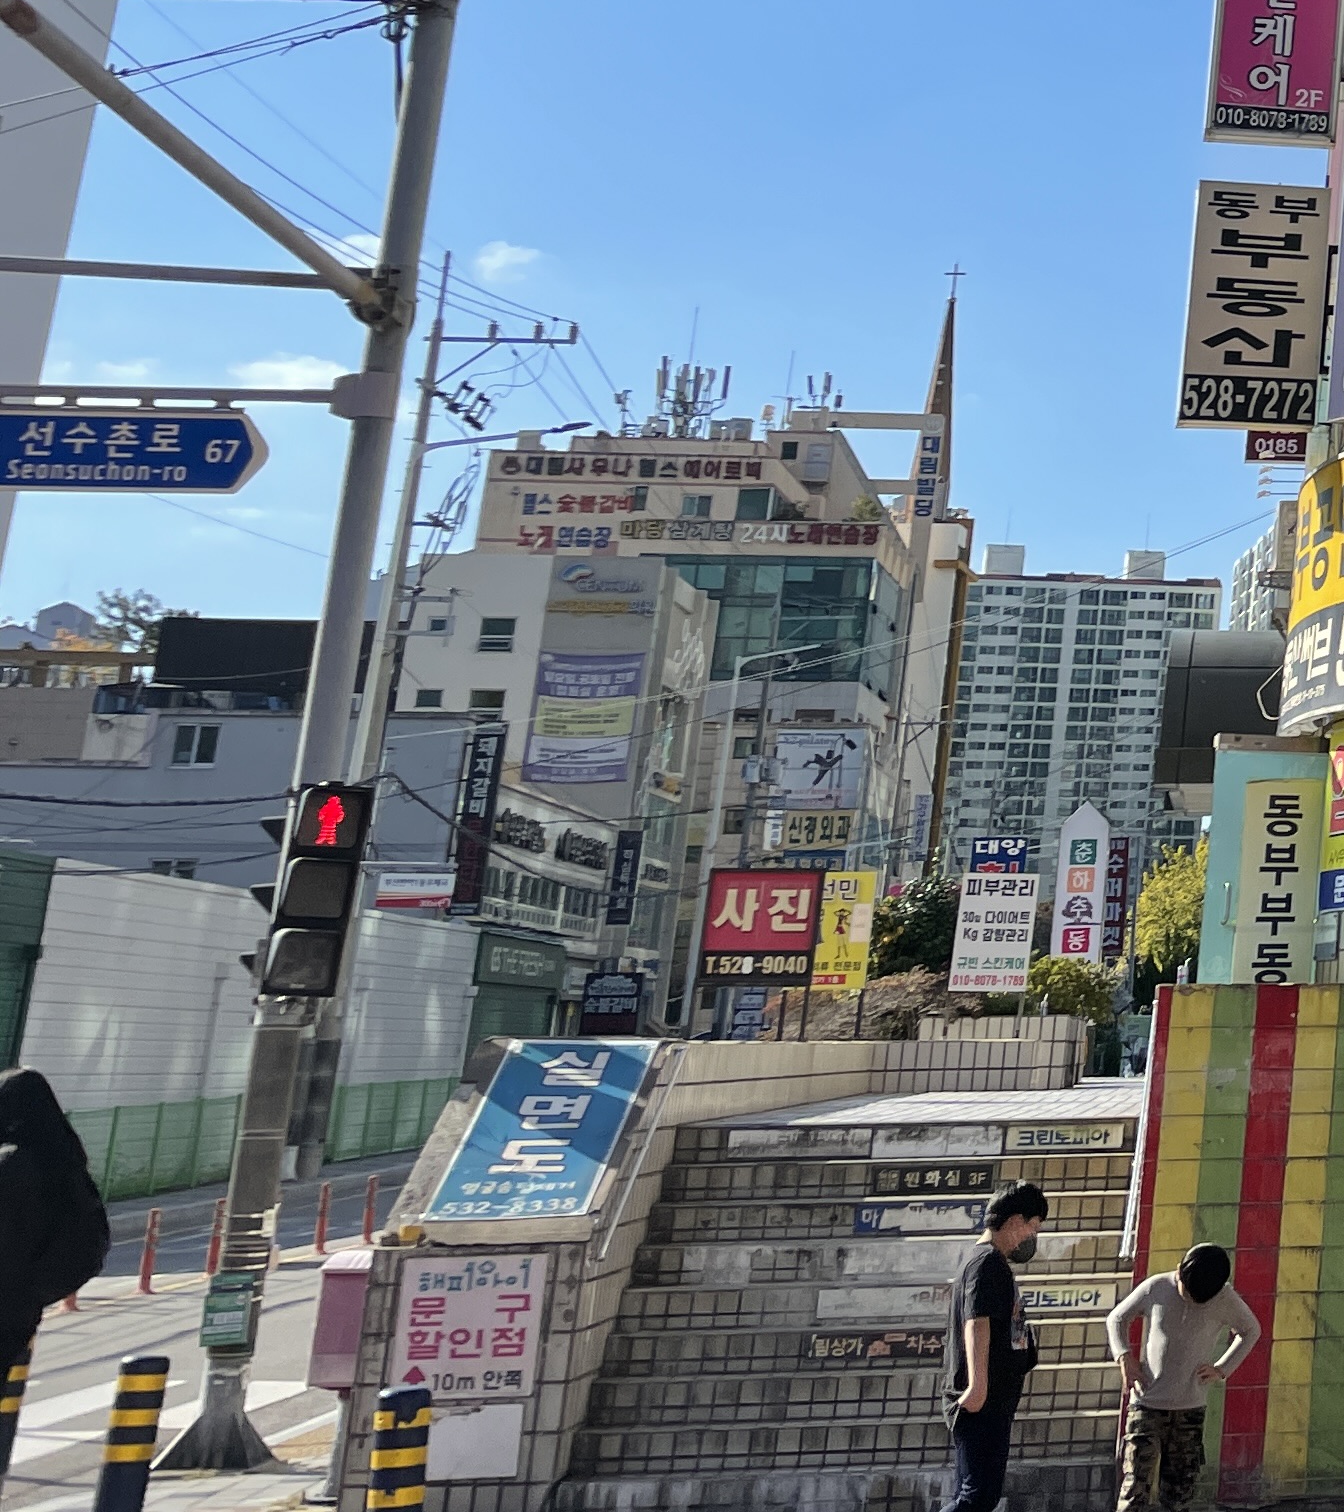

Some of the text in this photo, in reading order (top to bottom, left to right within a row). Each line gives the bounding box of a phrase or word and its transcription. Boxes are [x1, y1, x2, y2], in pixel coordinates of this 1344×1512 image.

[1295, 89, 1323, 109] 2F
[1216, 107, 1327, 133] 010-8078-1789
[1208, 190, 1319, 223] 동부
[1201, 229, 1309, 368] 부동산
[1182, 379, 1315, 420] 528-7272
[18, 421, 242, 464] 선수촌로 67
[1255, 438, 1298, 454] 0185
[5, 459, 187, 482] Seonsuchon-ro
[788, 814, 851, 844] 신경외과
[975, 839, 1026, 856] 대양
[966, 878, 1035, 897] 피부관리
[712, 888, 811, 932] 사진
[985, 910, 1030, 924] 다이어트
[982, 928, 1028, 942] 감량관리
[982, 957, 1025, 970] 스킨케어
[487, 1049, 606, 1176] 실면도
[1017, 1128, 1110, 1146] 크린토피아
[969, 1171, 988, 1186] 3F
[440, 1197, 578, 1215] 532-8338
[407, 1327, 527, 1360] 할인점
[432, 1370, 522, 1391] 10m 안쪽
